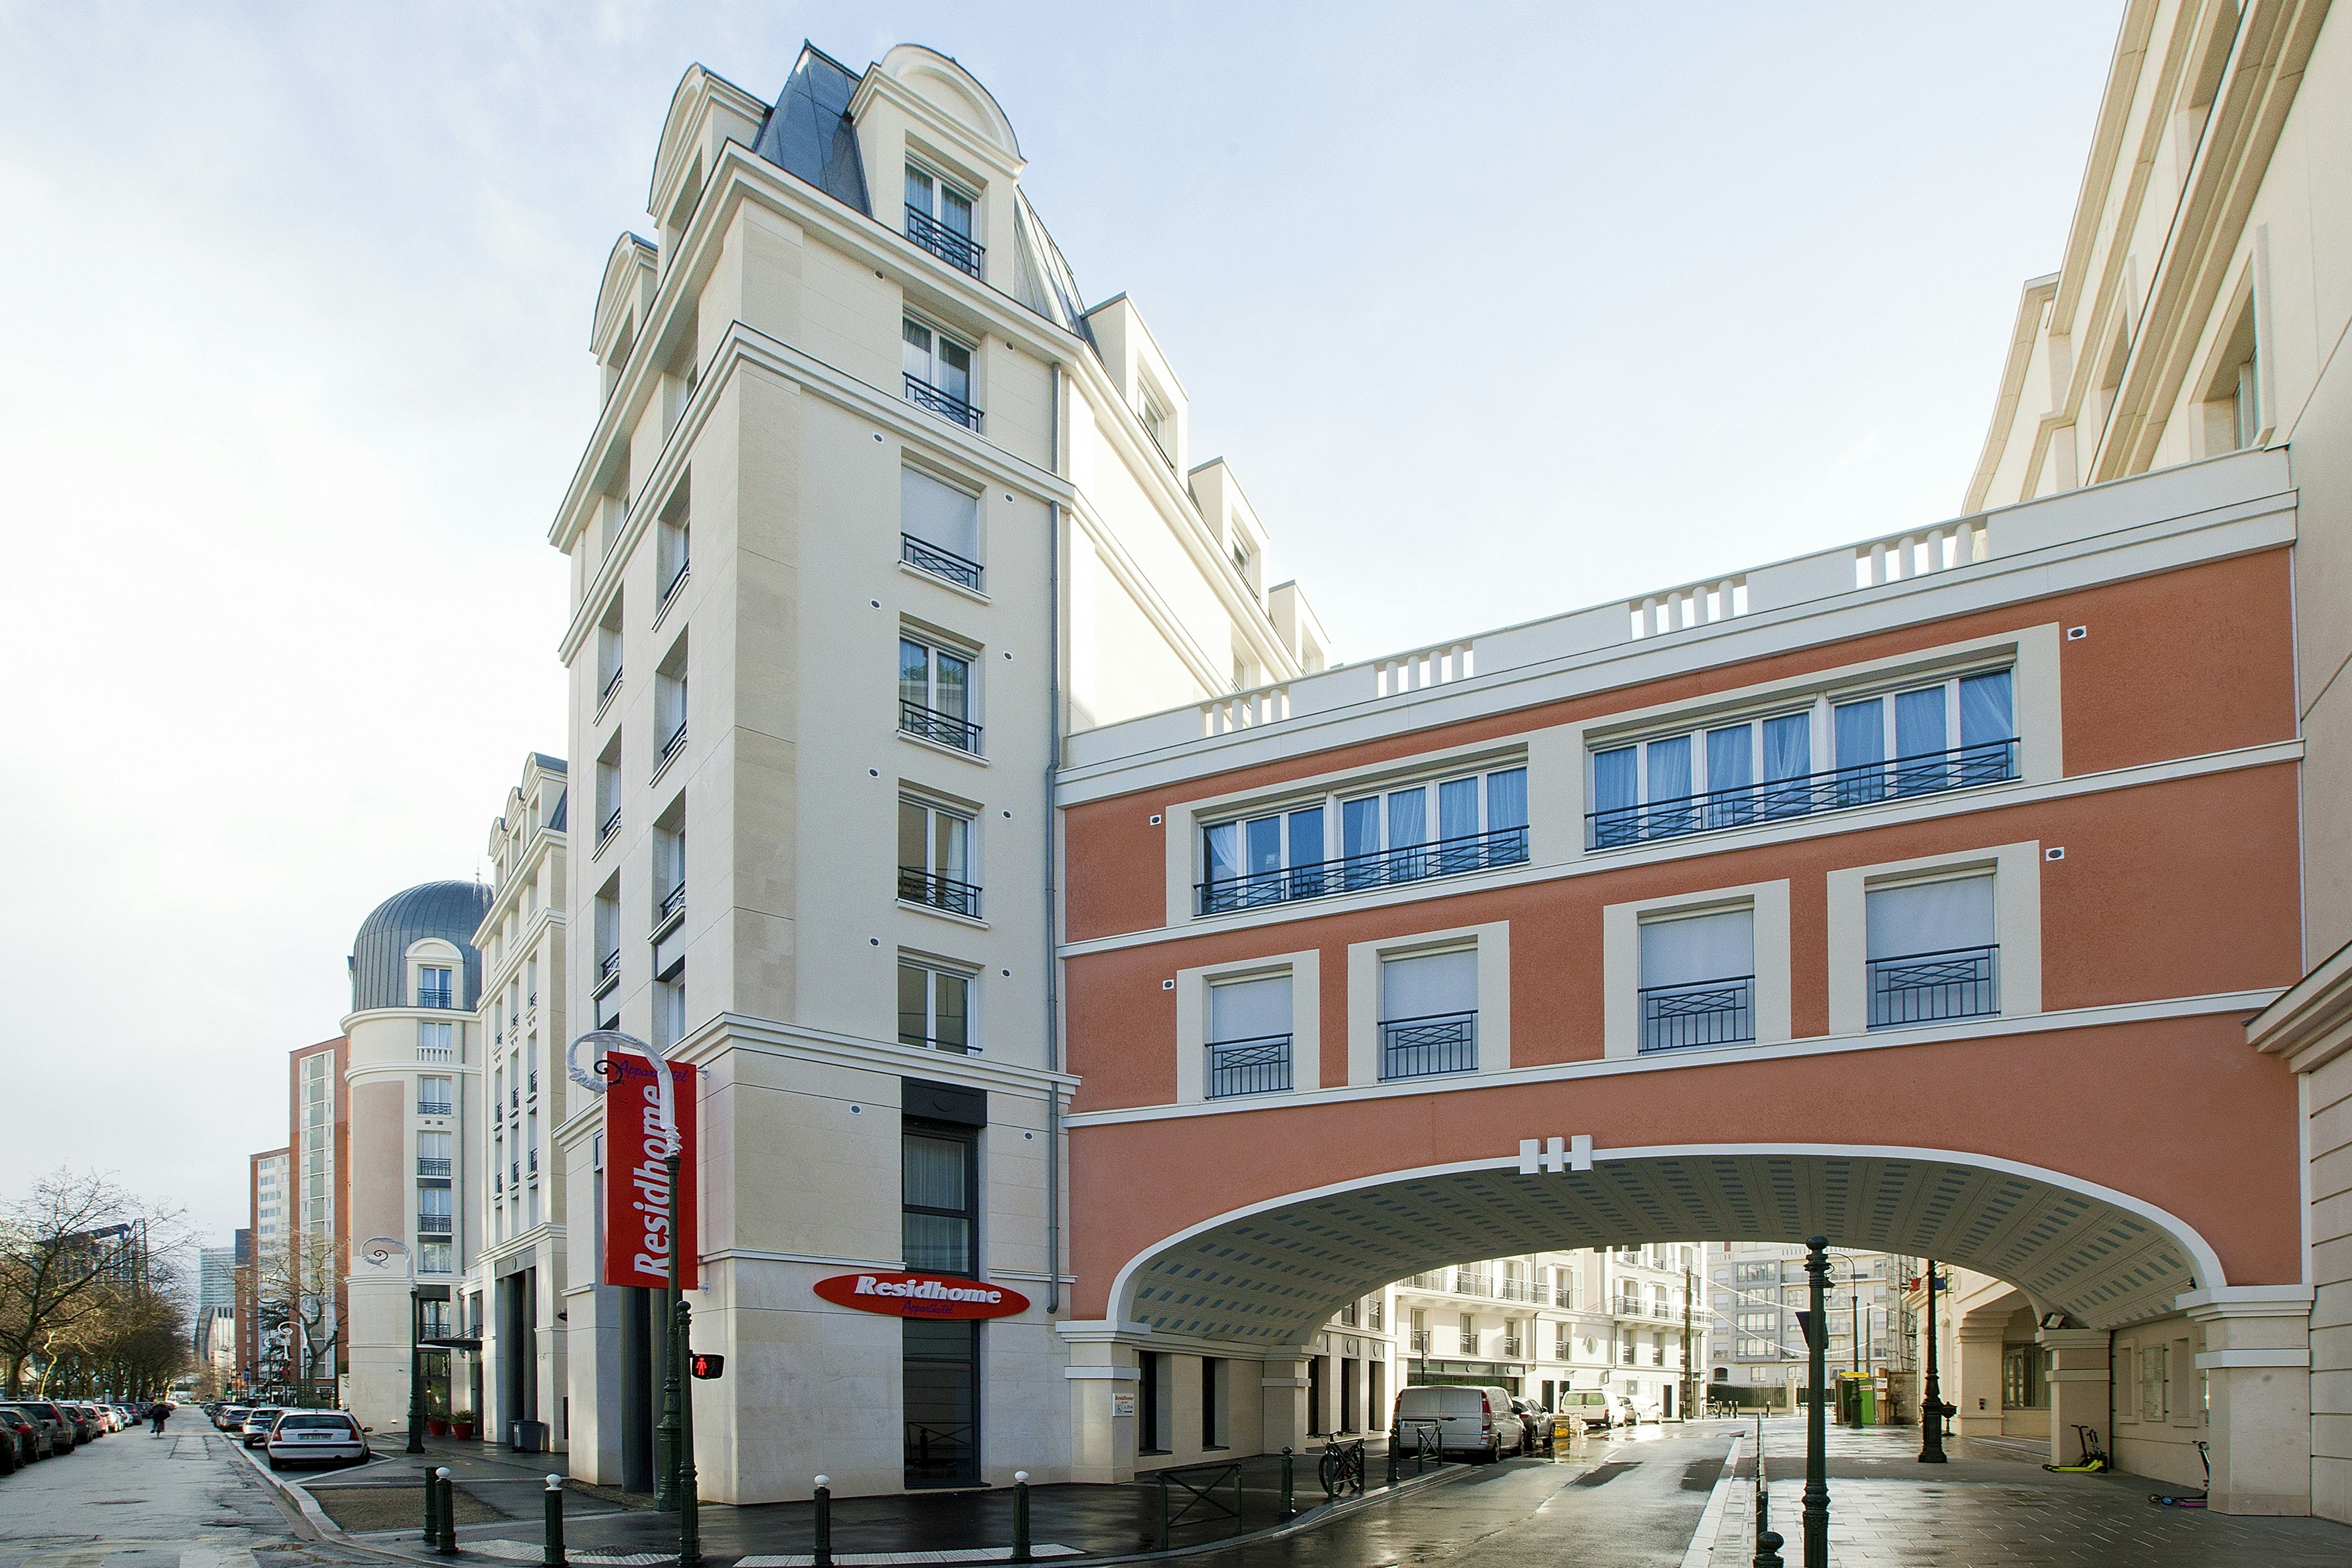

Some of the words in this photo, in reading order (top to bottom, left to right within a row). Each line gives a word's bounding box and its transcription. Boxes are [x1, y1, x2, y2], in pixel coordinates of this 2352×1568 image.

[615, 1059, 689, 1083] Appartel
[633, 1085, 669, 1279] Residhome
[854, 1276, 1002, 1304] Residhome
